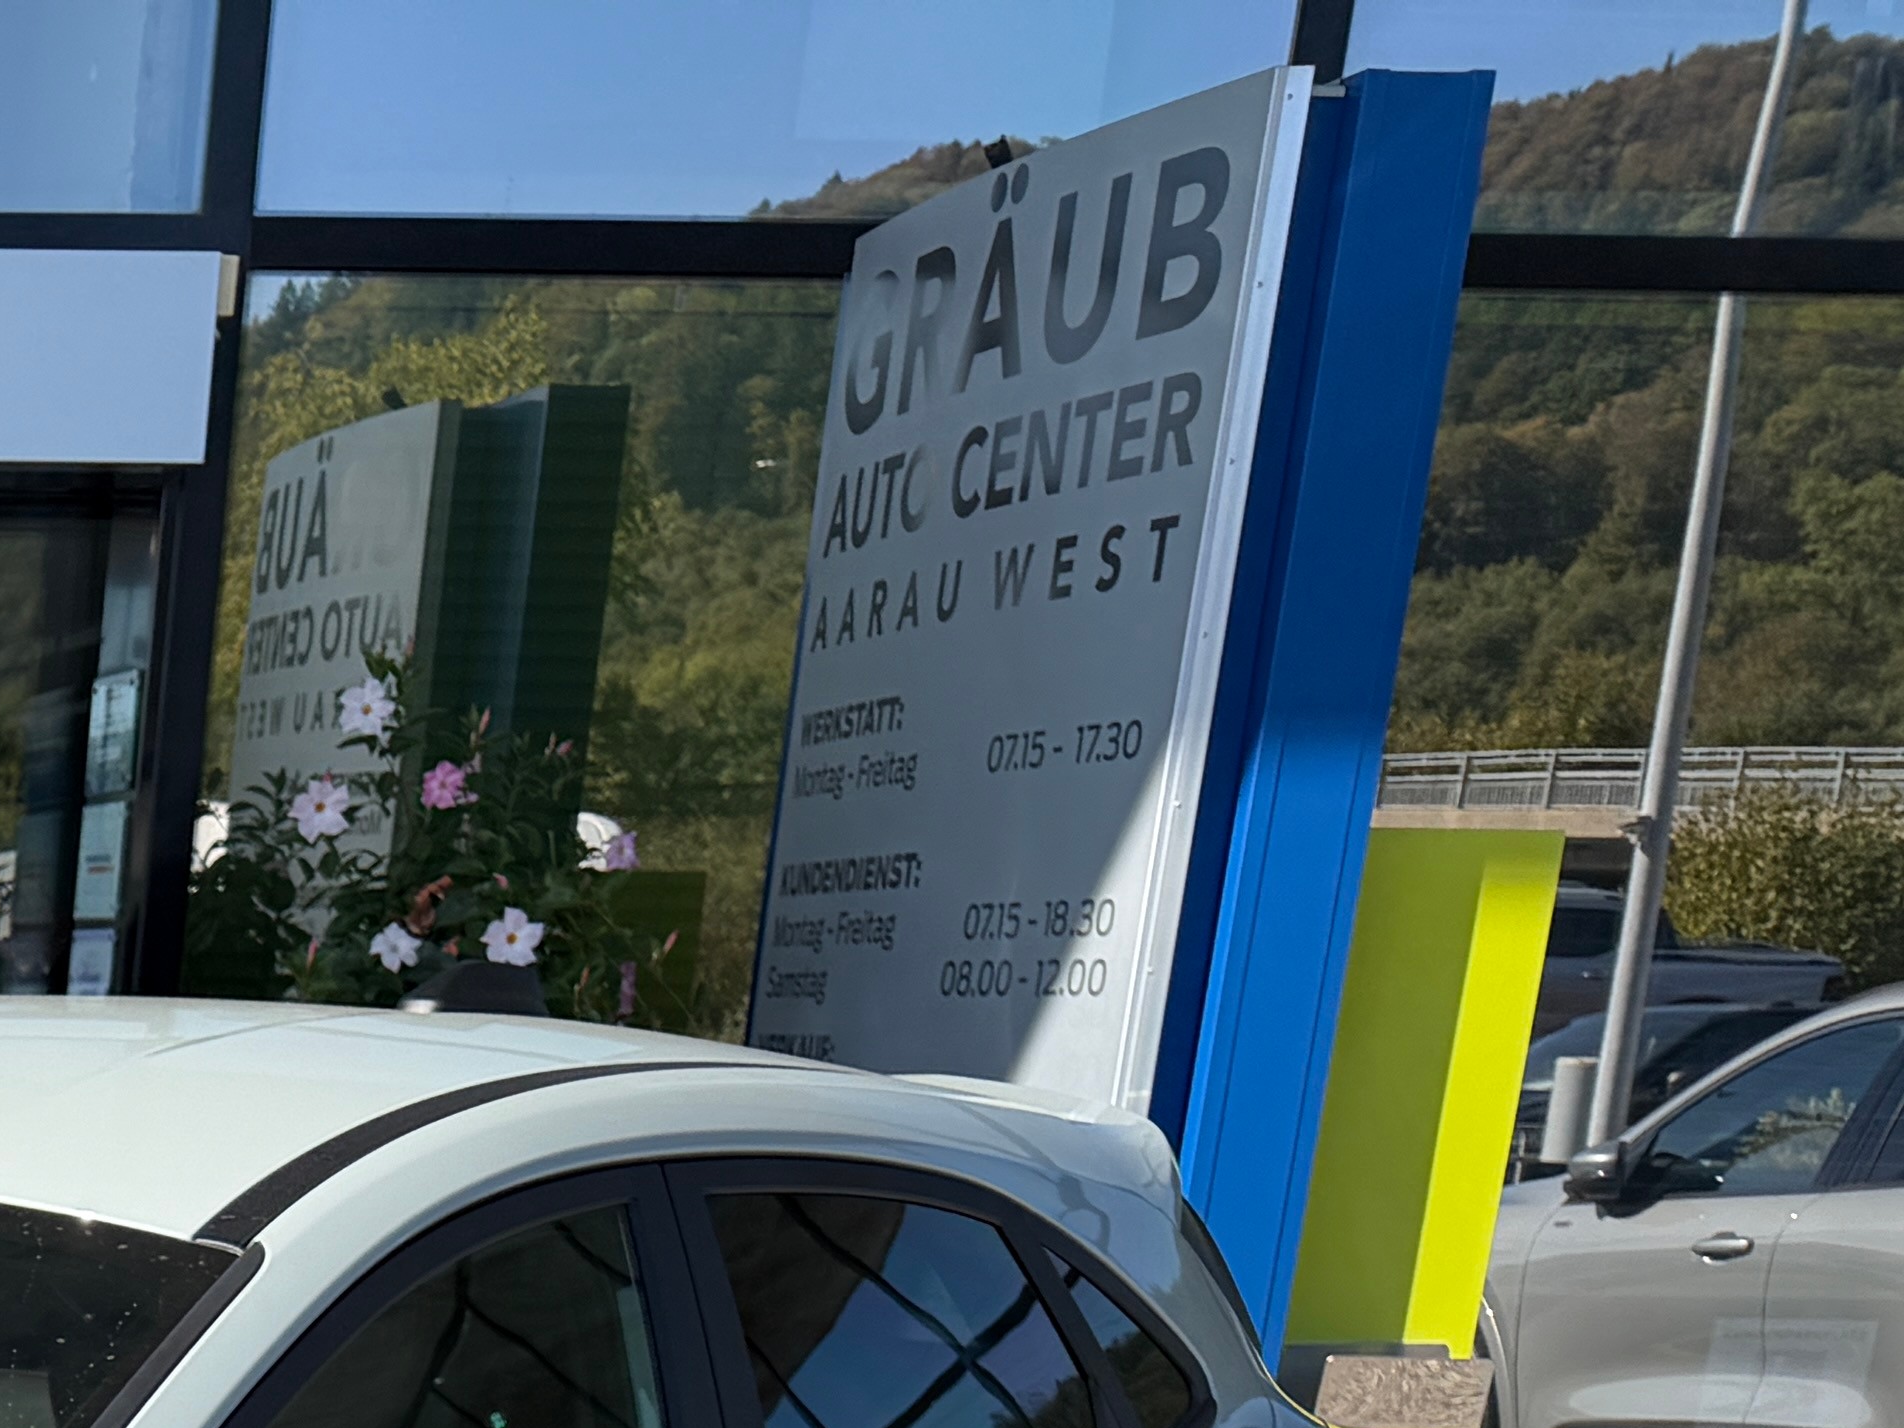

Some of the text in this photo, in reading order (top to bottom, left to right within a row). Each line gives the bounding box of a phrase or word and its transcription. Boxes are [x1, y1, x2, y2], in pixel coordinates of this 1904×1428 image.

[845, 146, 1230, 435] GRÄUB
[823, 372, 1203, 557] AUTO CENTER
[810, 515, 1180, 653] AARAU WEST
[800, 697, 904, 747] WERKSTATT:
[794, 758, 844, 800] Montag
[856, 750, 918, 791] Freitag
[987, 730, 1045, 774] 07.15
[1075, 719, 1143, 765] 17.30
[778, 852, 922, 897] KUNDENDIENST:
[963, 902, 1021, 941] 07.15
[1043, 898, 1116, 937] 18.30
[941, 959, 1013, 998] 08.00
[1034, 958, 1107, 998] 12.00
